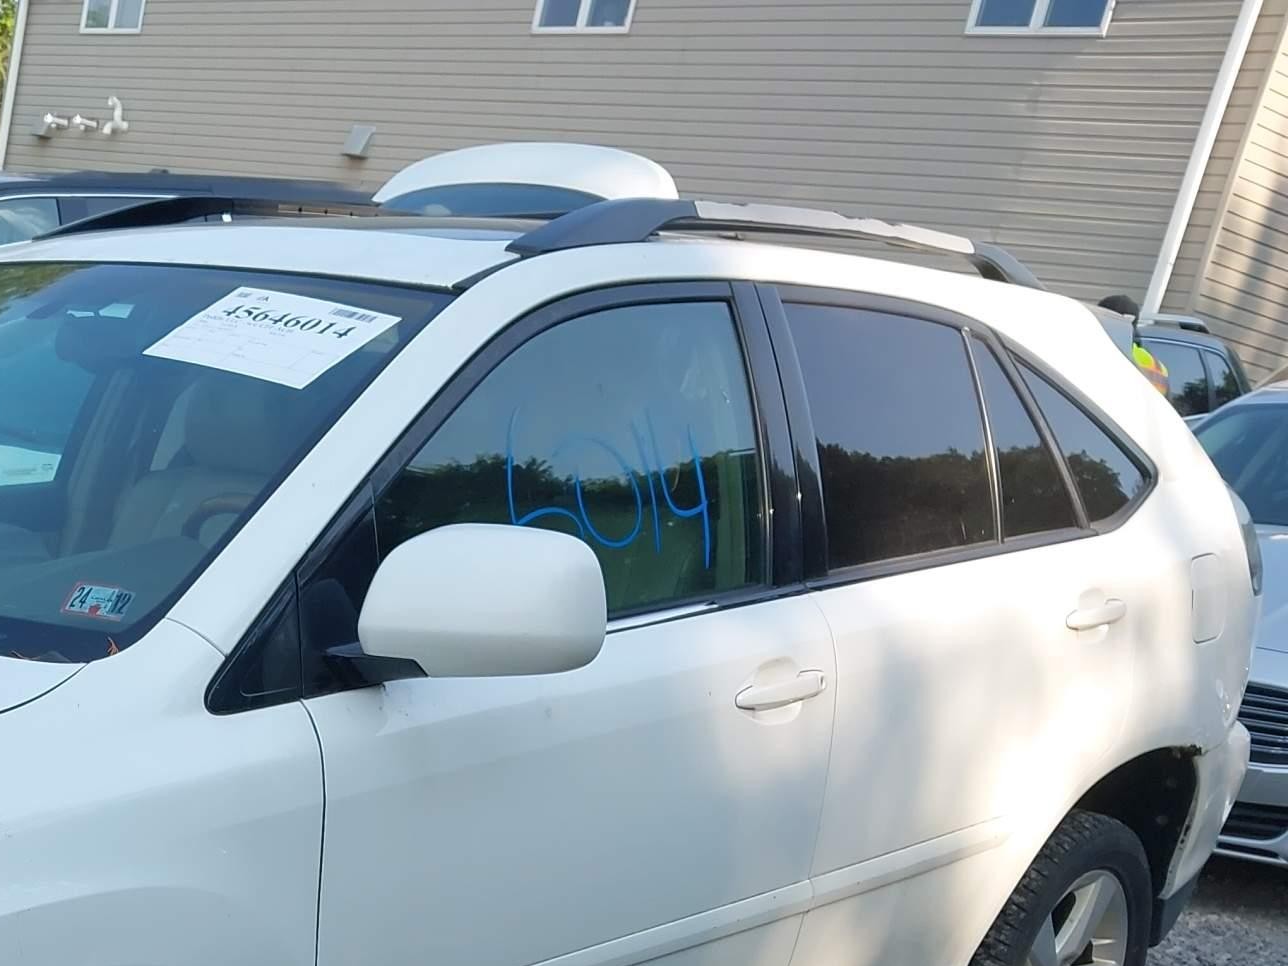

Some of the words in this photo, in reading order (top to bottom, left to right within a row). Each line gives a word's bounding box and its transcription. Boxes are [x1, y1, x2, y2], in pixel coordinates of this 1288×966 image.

[222, 304, 357, 339] 45646014
[506, 406, 711, 569] 6014
[69, 586, 93, 609] 24
